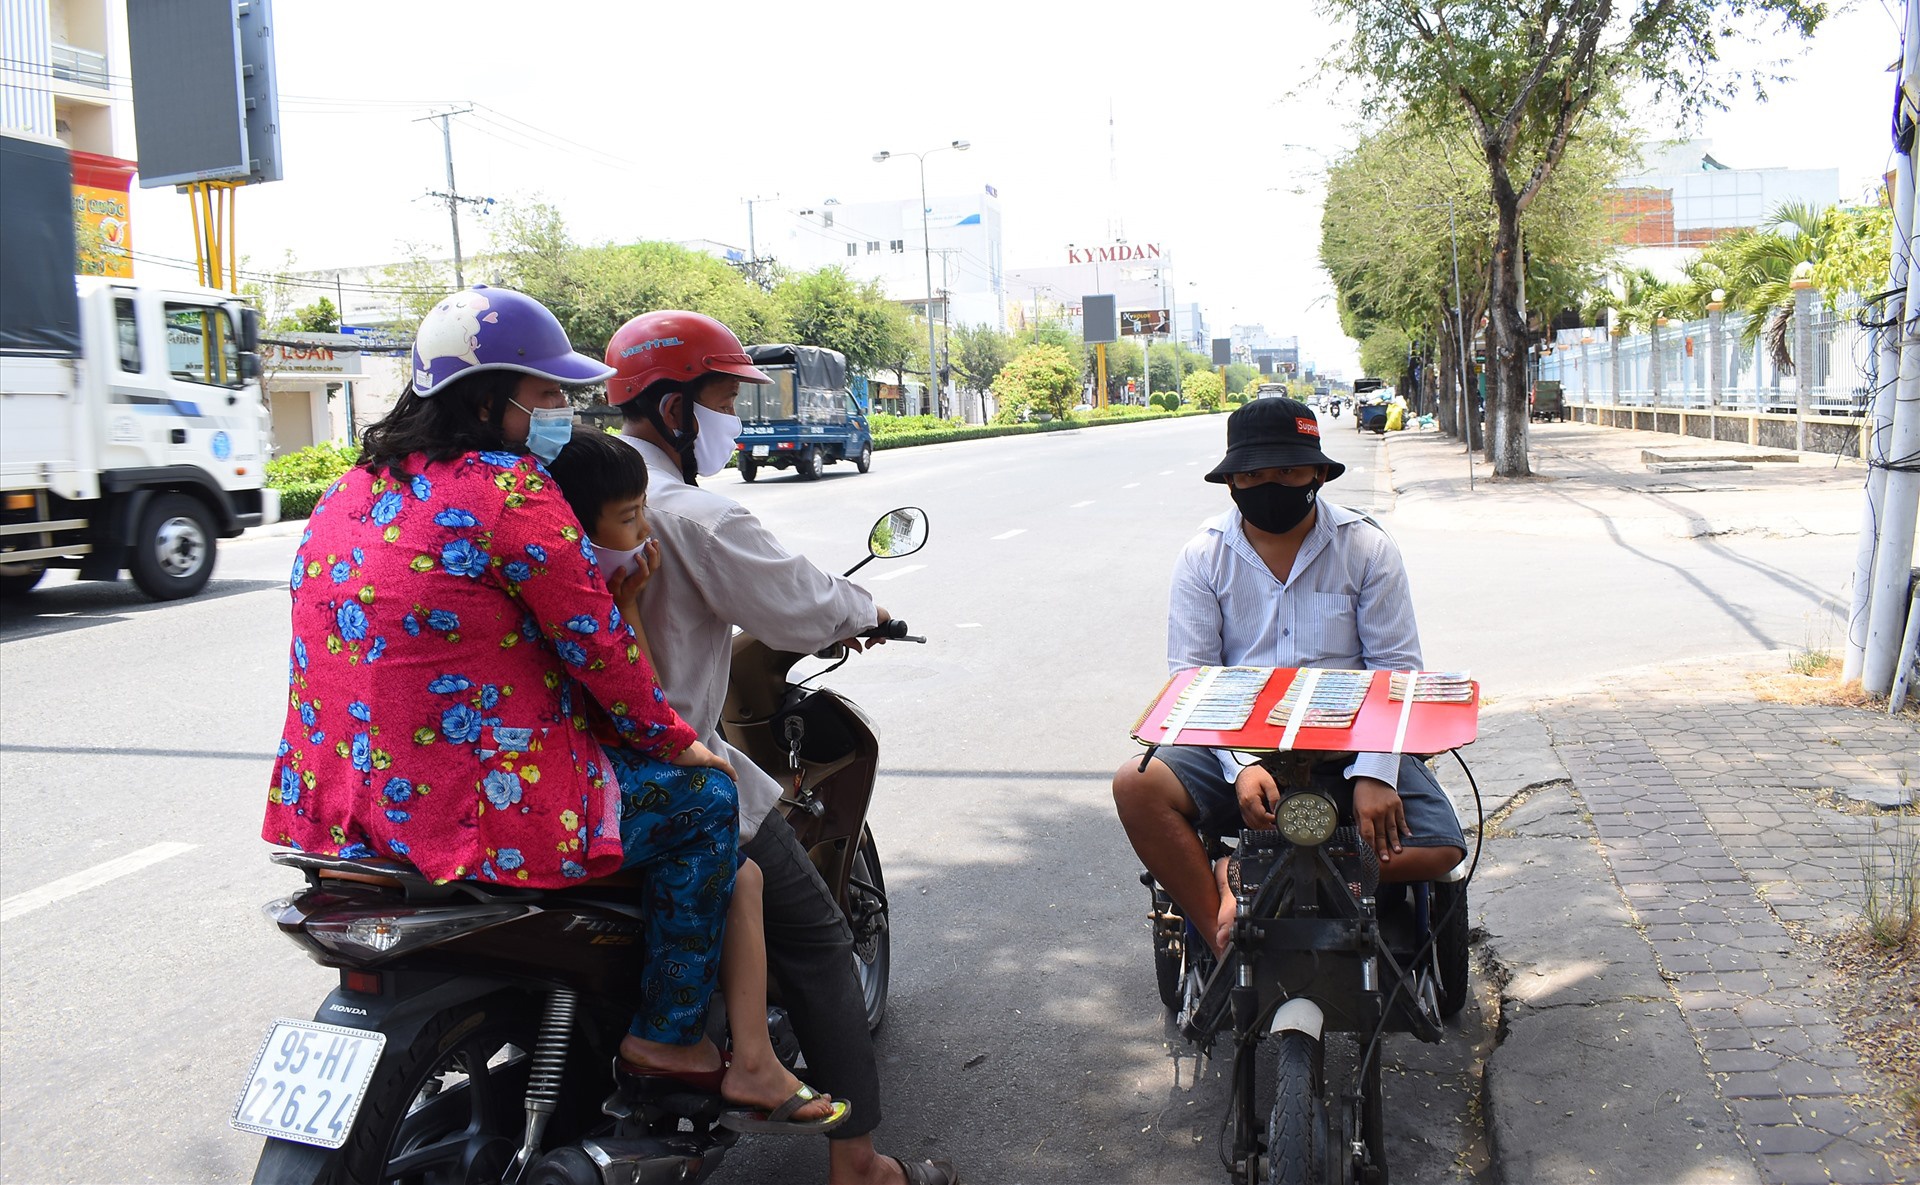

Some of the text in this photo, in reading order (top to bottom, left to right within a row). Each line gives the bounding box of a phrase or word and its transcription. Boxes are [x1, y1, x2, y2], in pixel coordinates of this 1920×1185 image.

[1069, 243, 1161, 264] KYMDAN
[654, 769, 687, 780] CHANEL
[591, 935, 634, 945] 125
[329, 1004, 368, 1016] HONDA
[273, 1030, 363, 1083] 95-H1
[240, 1077, 353, 1139] 226.24
